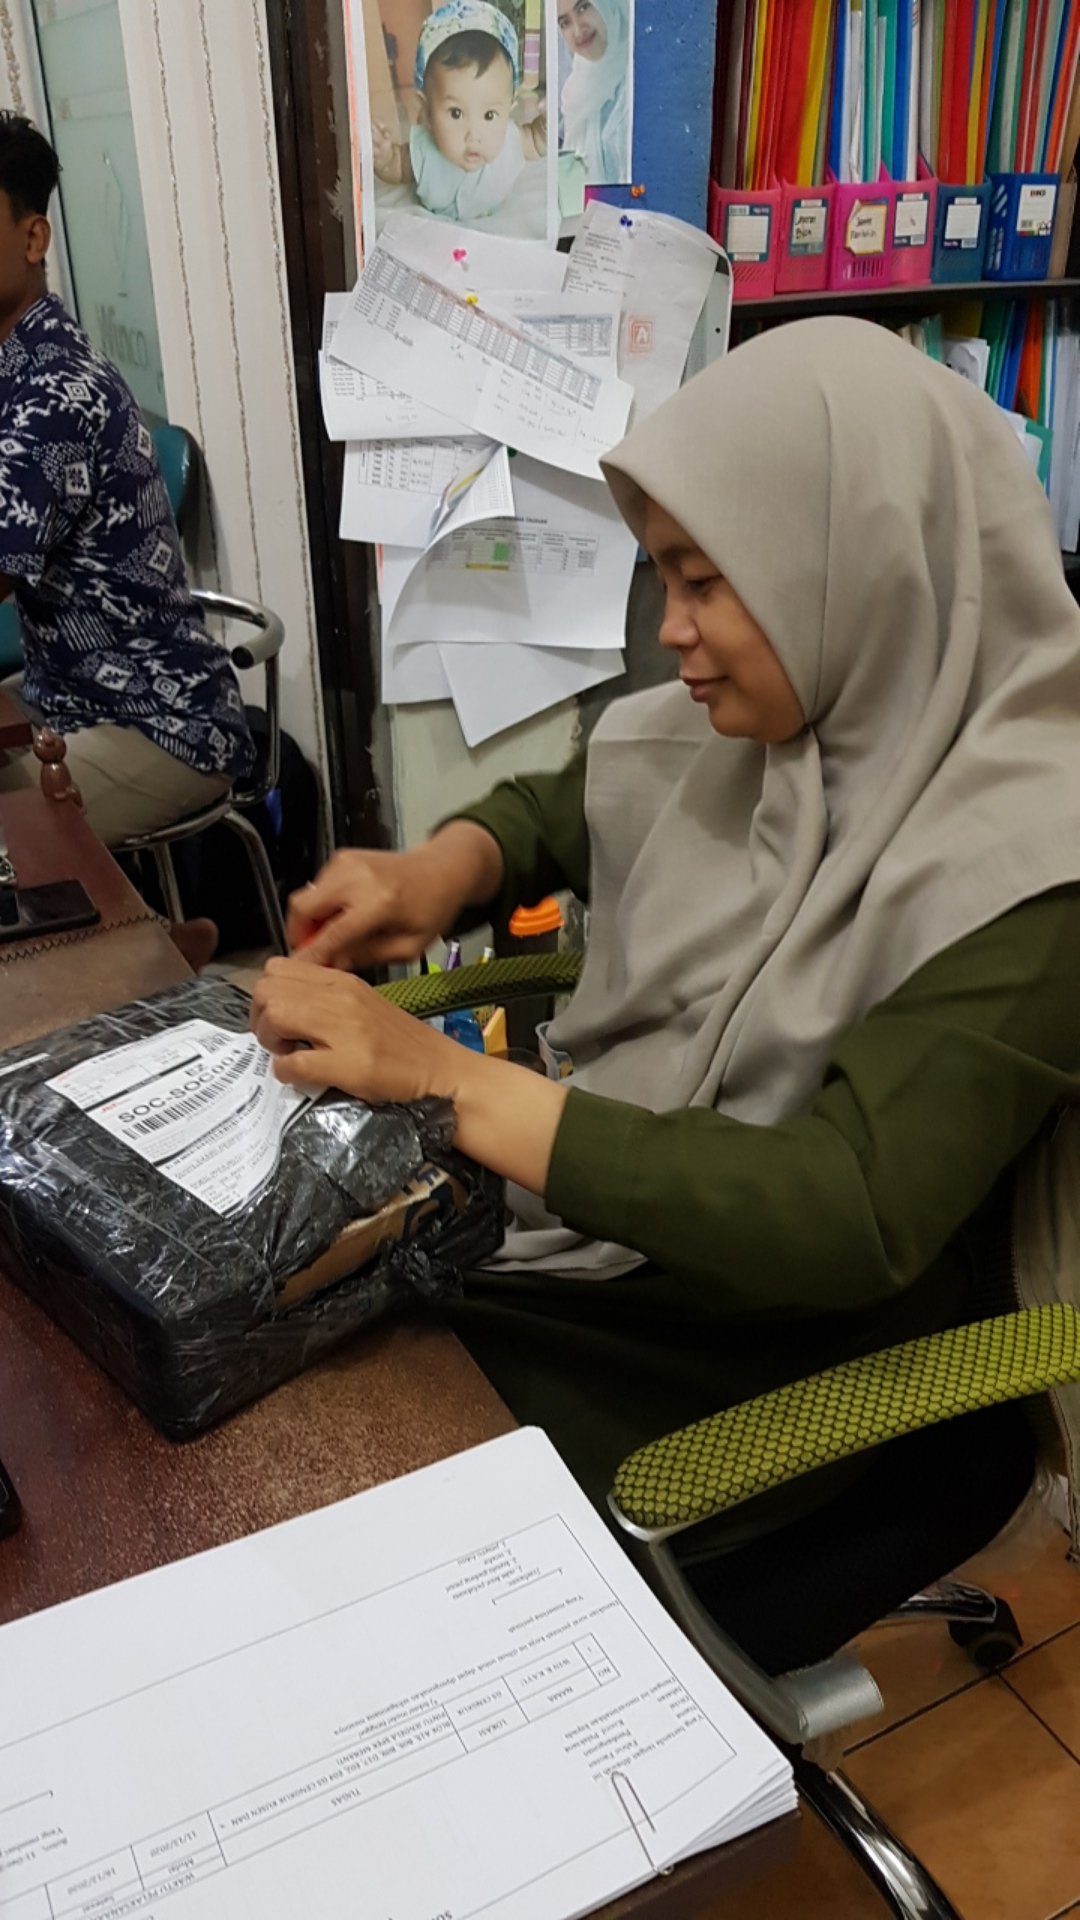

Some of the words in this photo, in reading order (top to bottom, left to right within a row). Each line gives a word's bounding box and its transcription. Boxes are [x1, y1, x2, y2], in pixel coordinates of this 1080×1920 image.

[184, 1062, 206, 1078] EZ
[596, 1666, 612, 1678] NO
[547, 1686, 574, 1703] NAMA
[422, 1711, 446, 1726] PINTU
[478, 1718, 508, 1737] LOKASI
[389, 1721, 422, 1741] JENDELA
[331, 1787, 361, 1807] TUGAS
[230, 1812, 251, 1827] DAN
[168, 1856, 195, 1875] Mulai
[159, 1871, 195, 1895] WAKTU
